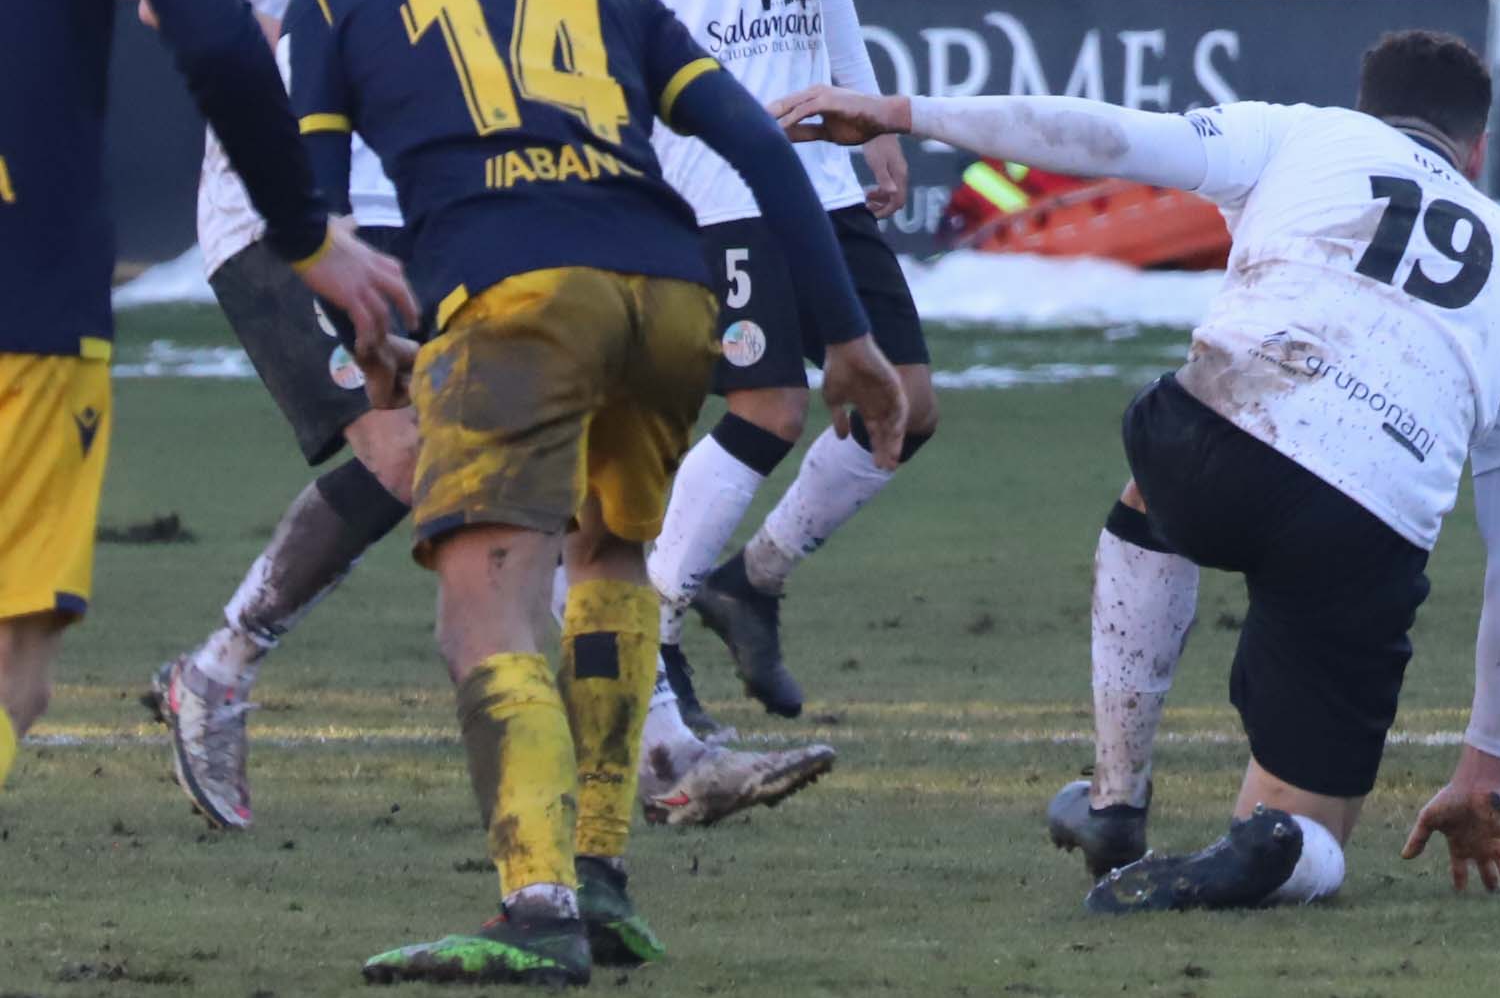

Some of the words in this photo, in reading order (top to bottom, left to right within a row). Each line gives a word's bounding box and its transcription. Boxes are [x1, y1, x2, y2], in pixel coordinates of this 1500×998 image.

[725, 248, 752, 309] 5
[1354, 175, 1494, 310] 19
[1305, 355, 1439, 455] gruponani
